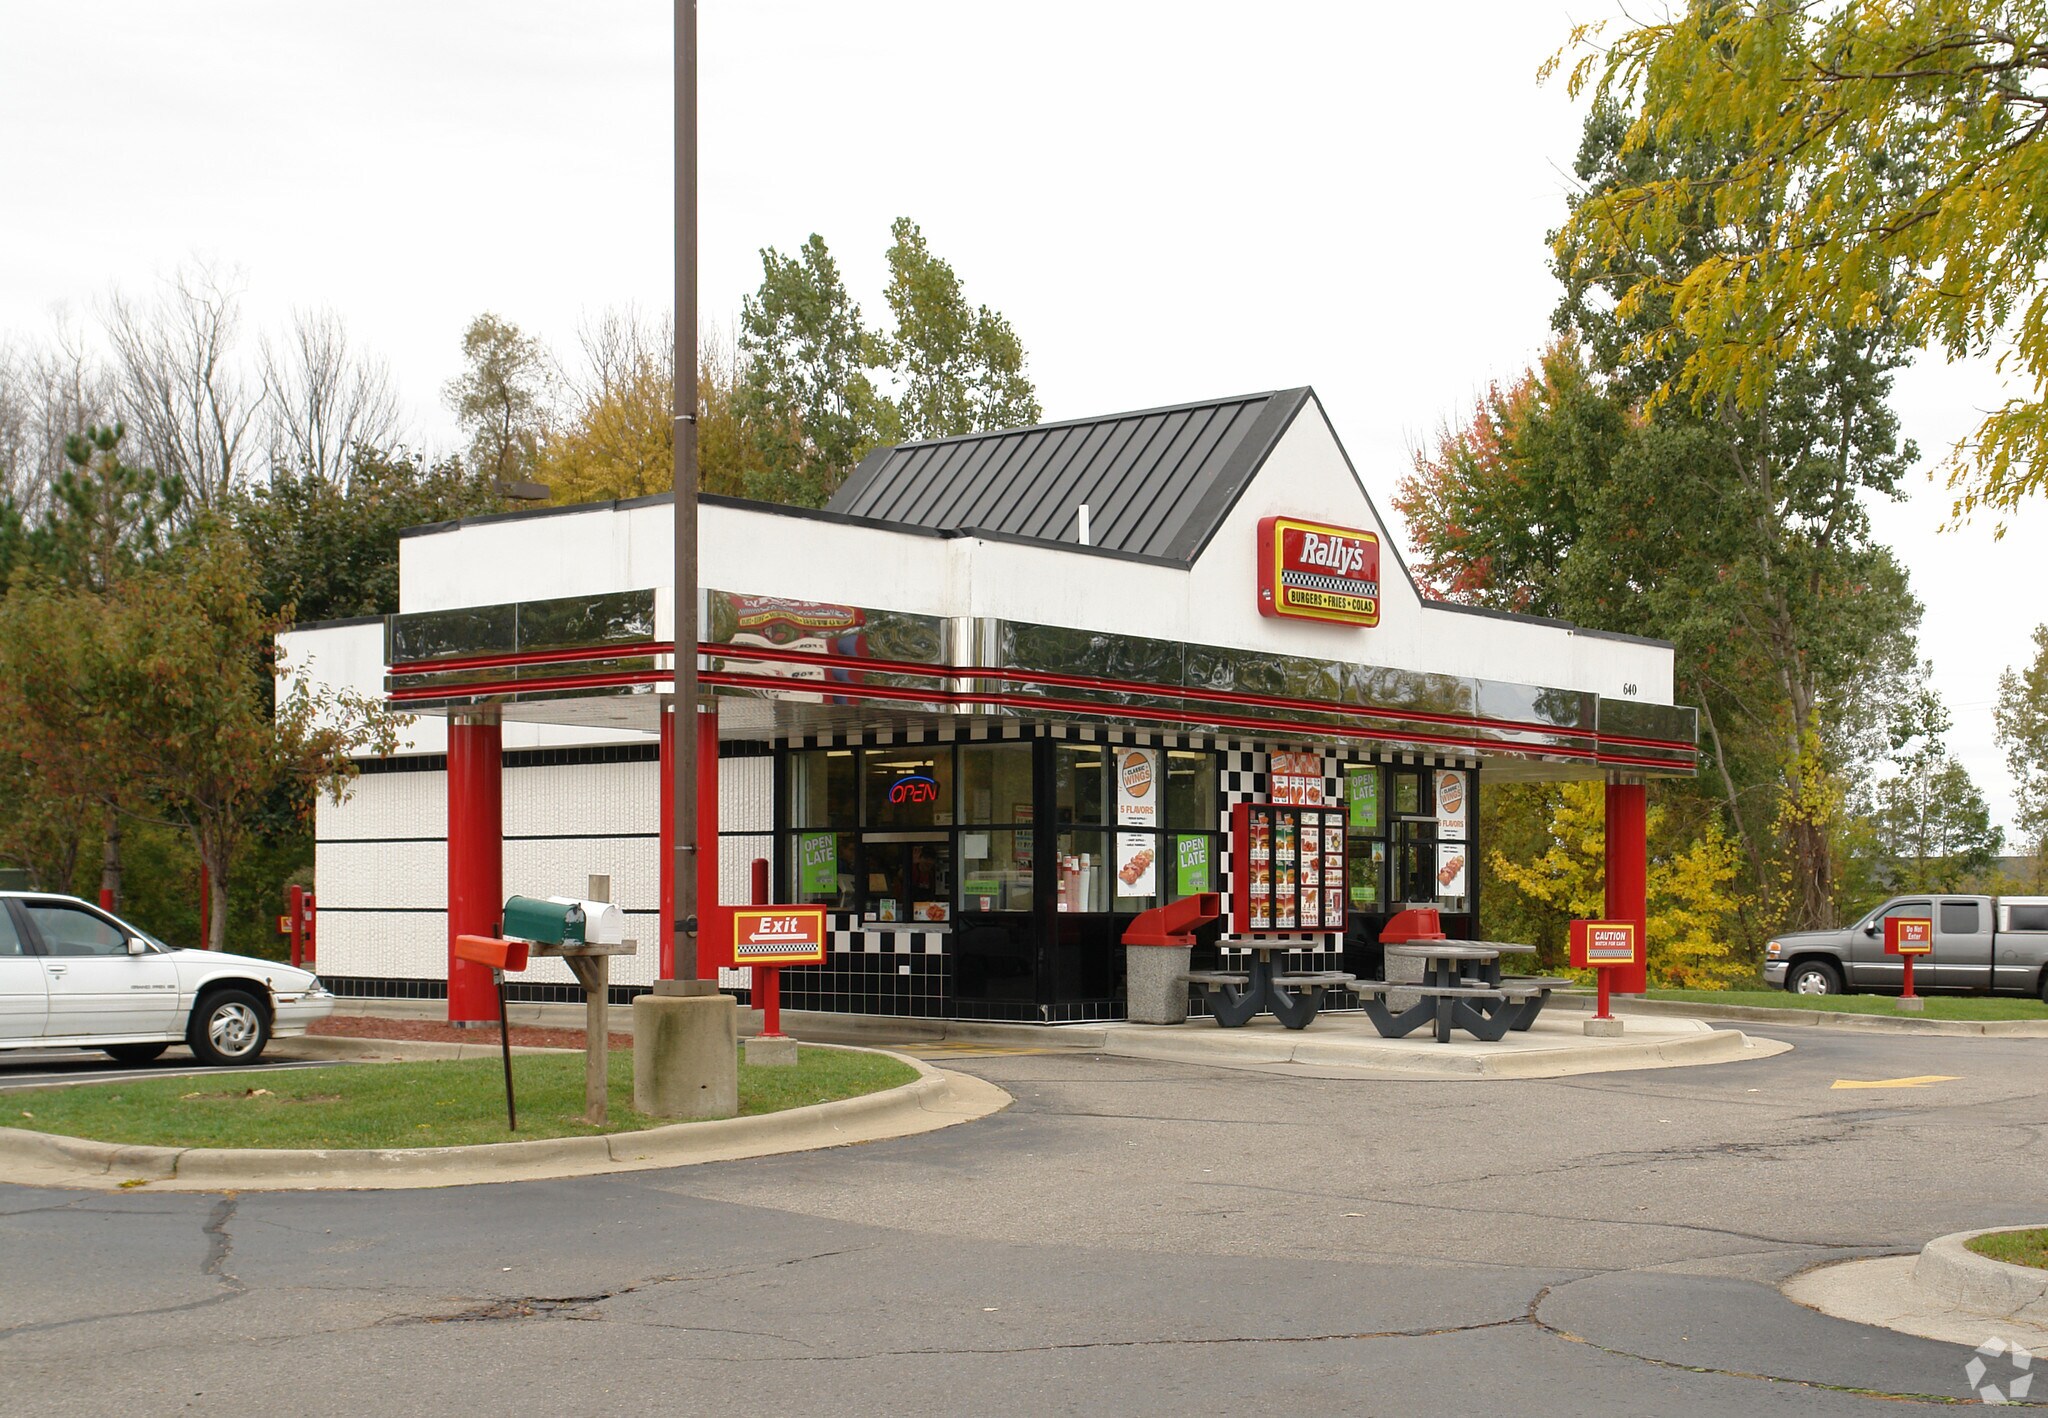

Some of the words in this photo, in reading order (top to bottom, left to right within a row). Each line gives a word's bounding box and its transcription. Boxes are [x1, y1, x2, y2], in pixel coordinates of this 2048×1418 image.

[1300, 532, 1364, 576] Rally's
[1291, 590, 1322, 606] BURGERS
[1327, 595, 1347, 609] FRIES
[1352, 599, 1373, 612] COLAS
[1623, 682, 1637, 696] 640
[1124, 770, 1150, 785] WINGS
[1127, 765, 1145, 775] CLASSIC
[1352, 773, 1374, 788] OPEN
[890, 783, 937, 803] OPEN
[1353, 785, 1375, 801] LATE
[1120, 805, 1125, 814] 5
[1126, 805, 1154, 815] FLAVORS
[1442, 820, 1464, 828] FLAVORS
[804, 835, 833, 852] OPEN
[1179, 837, 1205, 853] OPEN
[806, 847, 835, 866] LATE
[1180, 849, 1206, 868] LATE
[758, 917, 798, 933] Exit
[1906, 925, 1914, 933] Do
[1914, 925, 1923, 933] Not
[1594, 931, 1626, 941] CAUTION
